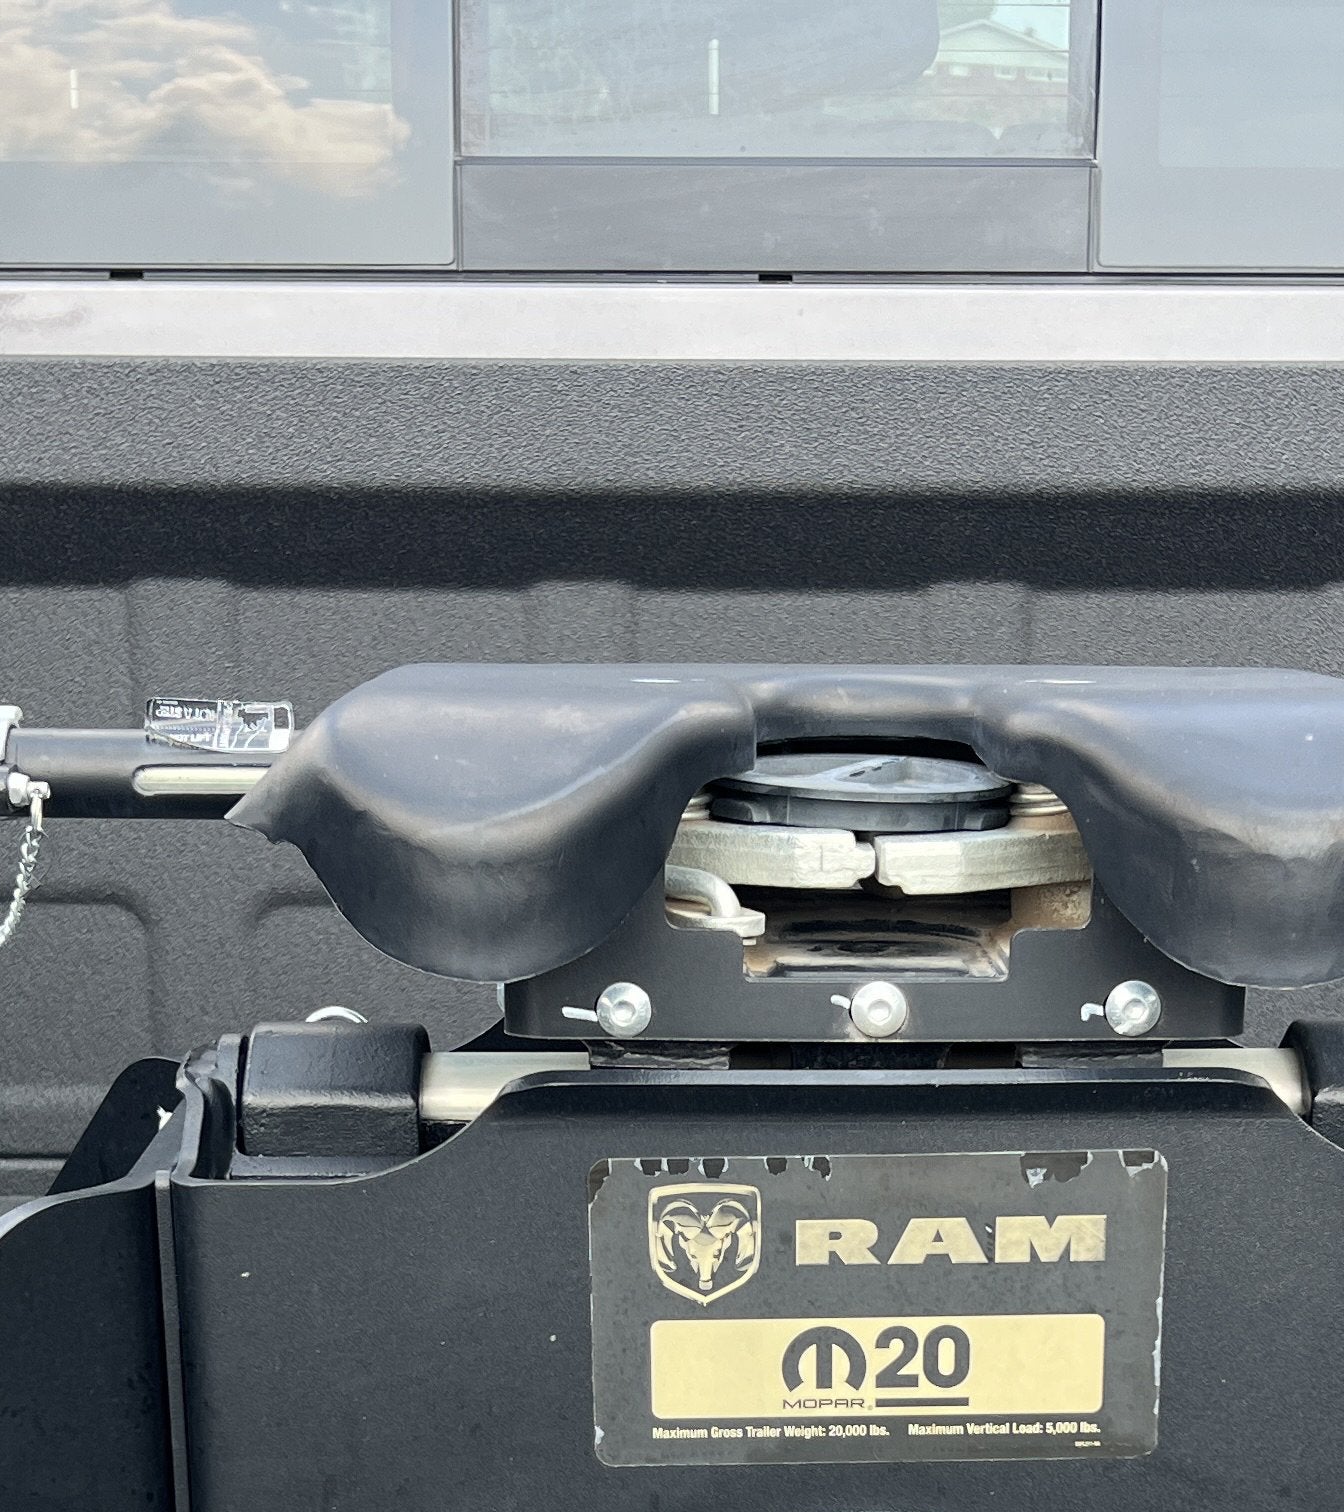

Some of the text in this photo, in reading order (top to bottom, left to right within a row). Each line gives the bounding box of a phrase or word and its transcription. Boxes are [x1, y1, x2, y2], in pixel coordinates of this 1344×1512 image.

[795, 1214, 1108, 1266] RAM
[782, 1398, 865, 1410] MOPAR
[652, 1424, 891, 1440] Maximum Gross Trailer Weight: 20,000 lbs.
[908, 1421, 1102, 1436] Maximum Vertical Load: 5,000 lbs.
